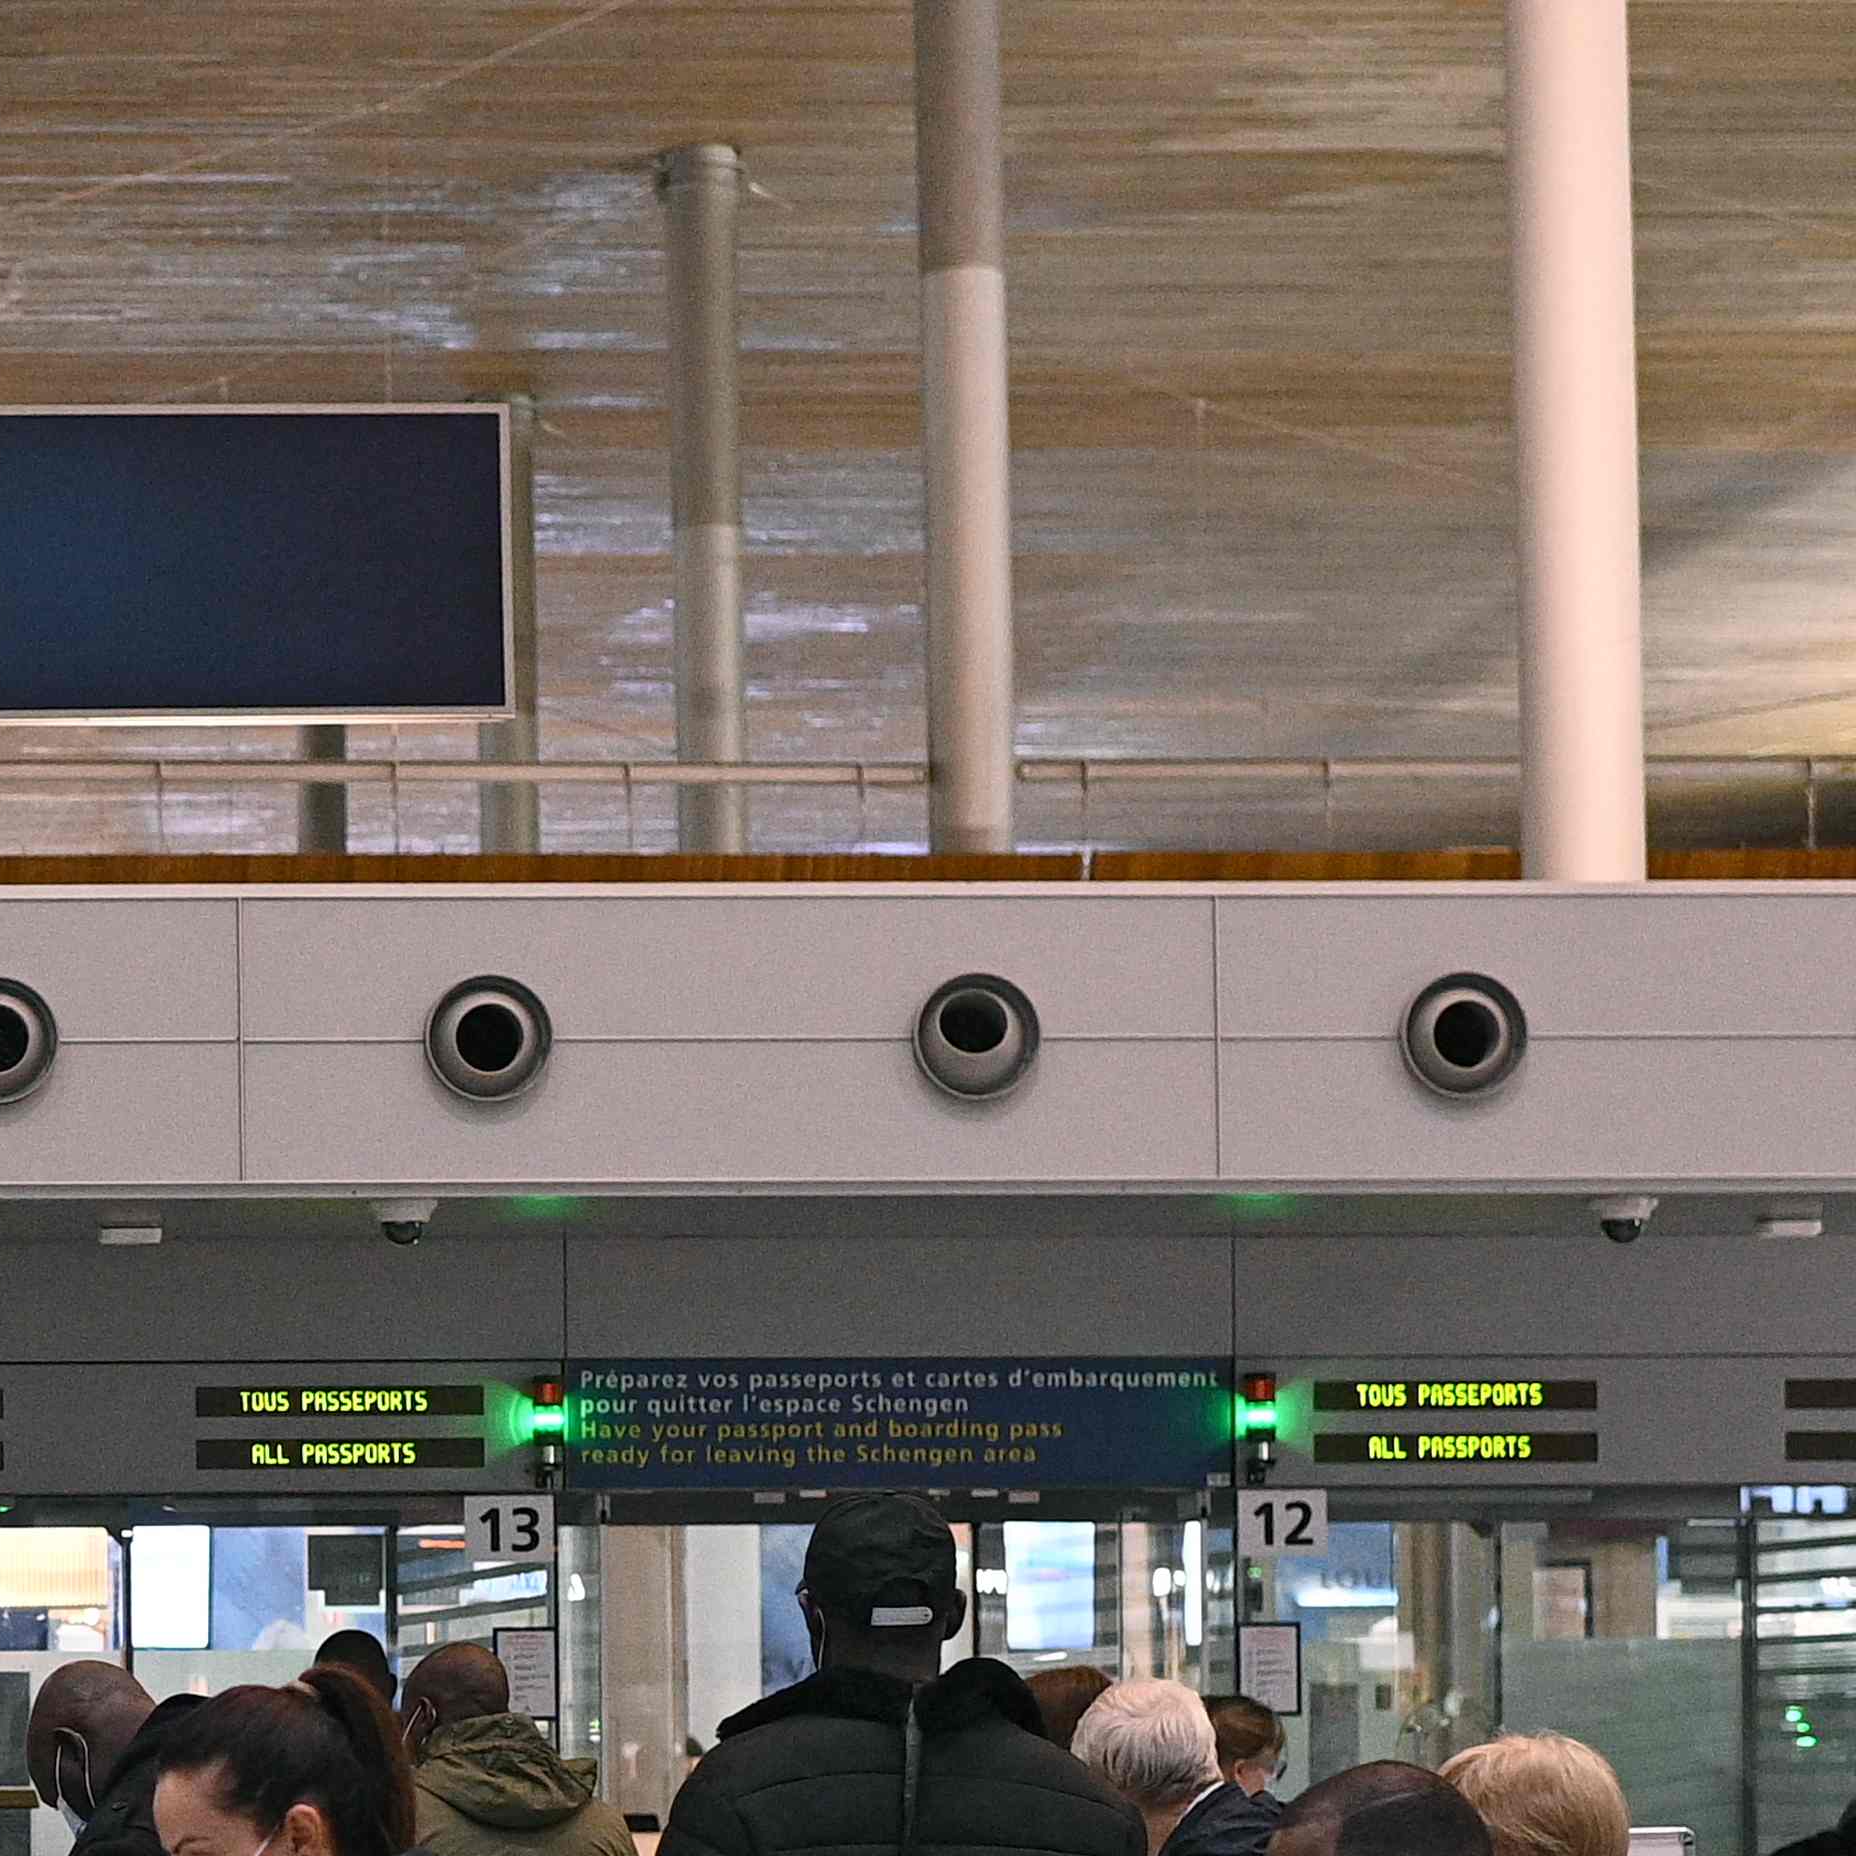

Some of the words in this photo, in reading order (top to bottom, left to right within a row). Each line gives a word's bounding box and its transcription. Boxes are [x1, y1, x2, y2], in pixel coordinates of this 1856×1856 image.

[580, 1370, 688, 1392] Préparez
[698, 1373, 739, 1388] vos
[750, 1371, 882, 1391] passeports
[892, 1371, 916, 1387] et
[926, 1370, 999, 1387] cartes
[240, 1392, 289, 1411] TOUS
[302, 1391, 427, 1411] PASSEPORTS
[581, 1398, 638, 1416] pour
[647, 1394, 733, 1416] quitter
[852, 1393, 969, 1415] Schengen
[1357, 1384, 1406, 1406] TOUS
[1419, 1383, 1542, 1406] PASSEPORTS
[581, 1420, 641, 1437] Have
[652, 1422, 707, 1441] your
[718, 1420, 824, 1440] passport
[834, 1419, 878, 1436] and
[889, 1418, 999, 1440] boarding
[1010, 1421, 1063, 1439] pass
[252, 1444, 289, 1464] ALL
[302, 1443, 415, 1464] PASSPORTS
[581, 1445, 649, 1466] ready
[660, 1445, 696, 1463] for
[706, 1445, 796, 1466] leaving
[807, 1444, 846, 1462] the
[856, 1444, 975, 1465] Schengen
[984, 1447, 1037, 1461] area
[1369, 1436, 1406, 1459] ALL
[1419, 1436, 1530, 1458] PASSPORTS
[480, 1507, 539, 1552] 13
[1254, 1501, 1313, 1545] 12
